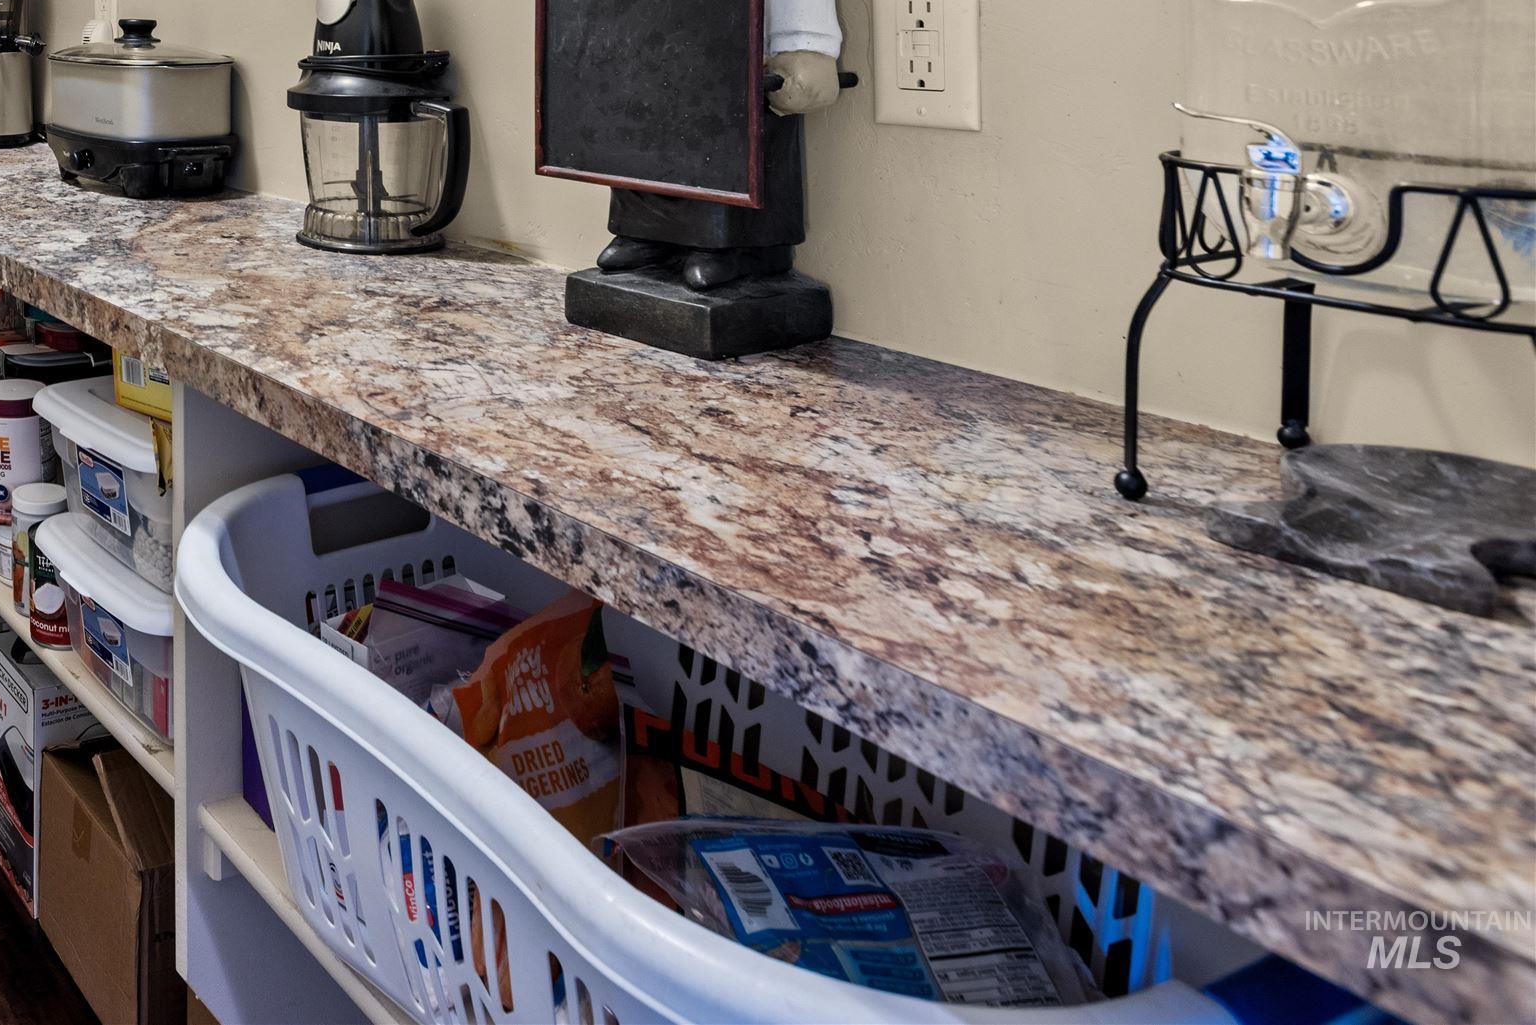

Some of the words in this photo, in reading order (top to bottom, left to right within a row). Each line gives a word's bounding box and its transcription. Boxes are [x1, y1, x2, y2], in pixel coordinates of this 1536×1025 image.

[316, 39, 342, 53] NINJA
[36, 555, 54, 568] THA
[394, 645, 419, 665] pure
[41, 694, 80, 711] 3-IN-
[512, 740, 565, 777] DRIED
[520, 756, 590, 800] GERINES
[404, 879, 418, 921] inCo
